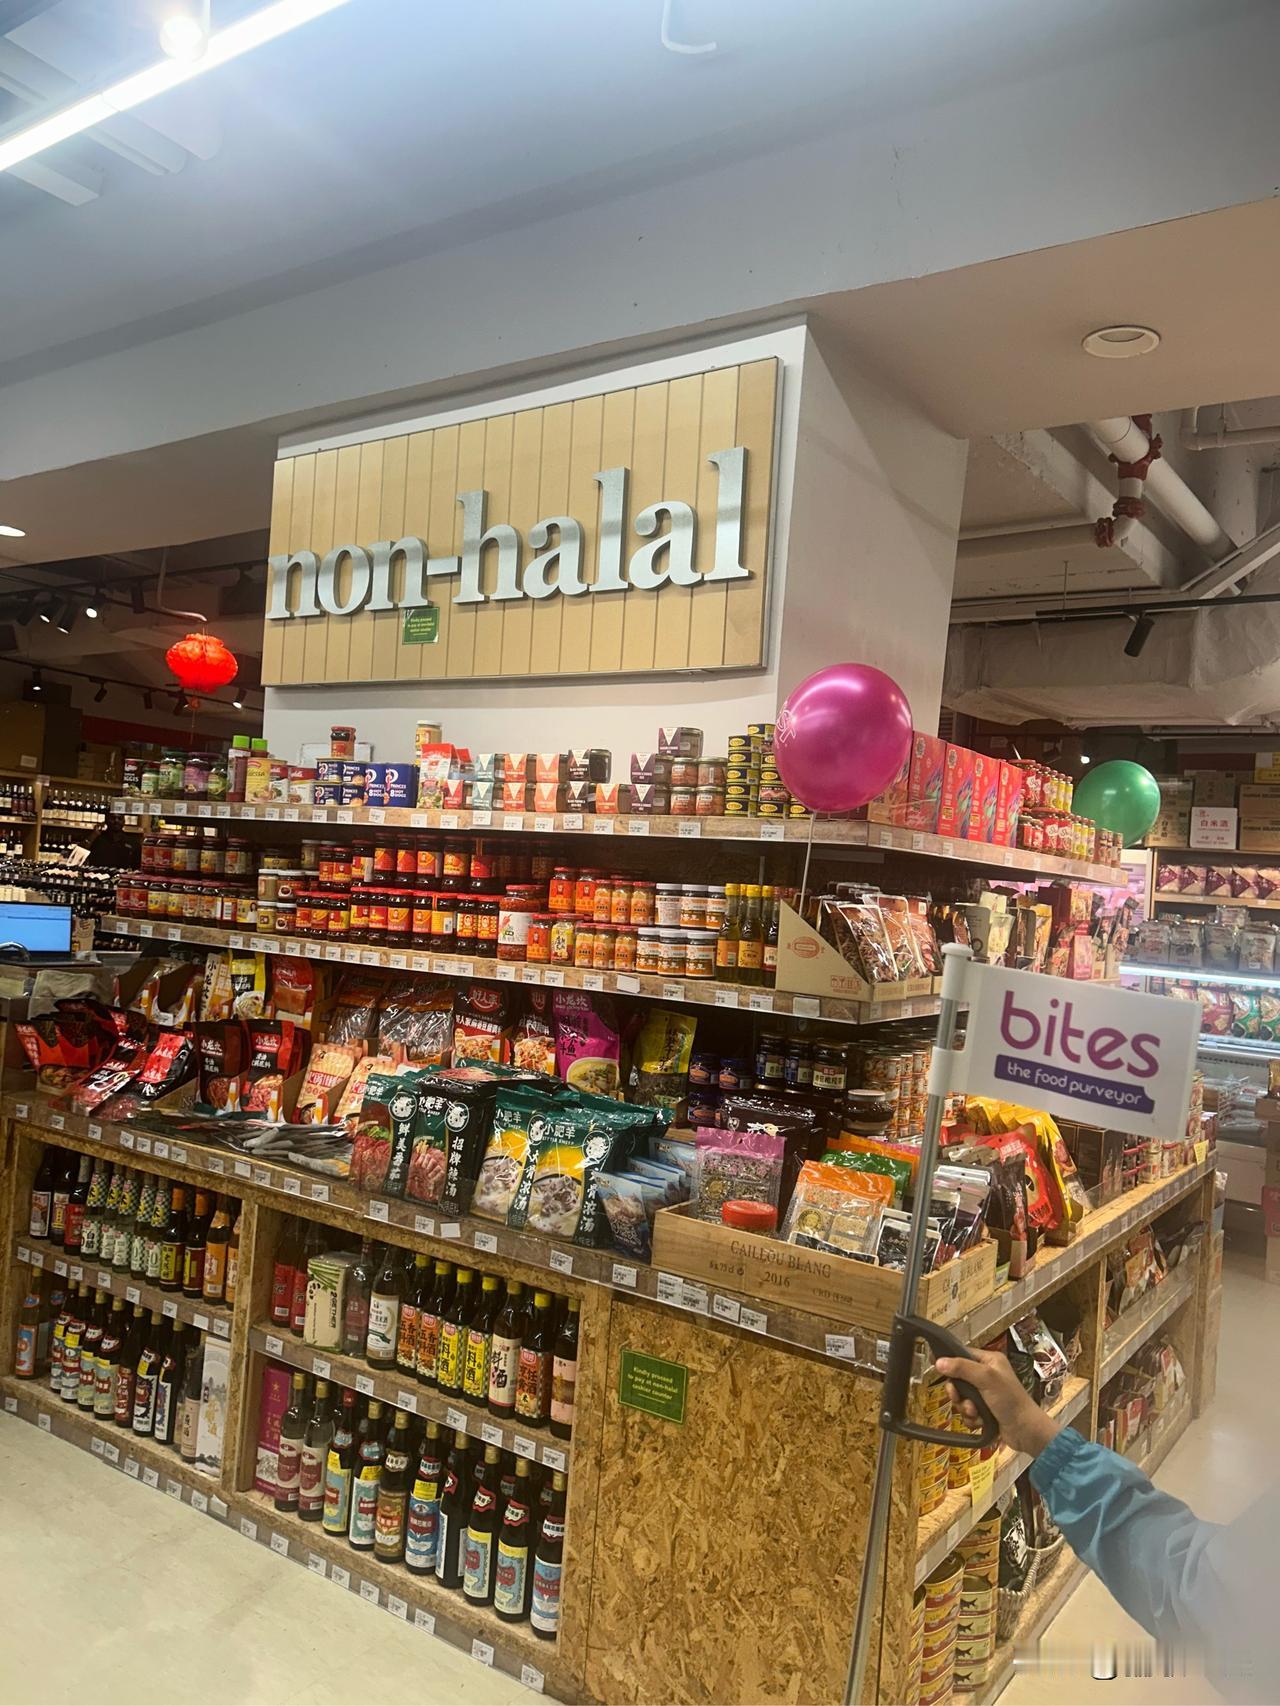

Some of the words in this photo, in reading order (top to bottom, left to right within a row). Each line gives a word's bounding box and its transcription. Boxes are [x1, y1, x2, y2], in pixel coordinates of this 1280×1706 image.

[267, 446, 751, 621] non-halal
[1000, 990, 1161, 1078] bites
[1007, 1061, 1031, 1079] the
[1034, 1068, 1068, 1088] food
[1069, 1079, 1142, 1105] purveyor
[495, 1109, 522, 1124] 小肥羊
[545, 1124, 576, 1139] 小肥羊
[765, 1271, 791, 1288] 2016
[633, 1366, 651, 1378] Kindly
[651, 1373, 673, 1384] proceed
[634, 1376, 645, 1384] pay
